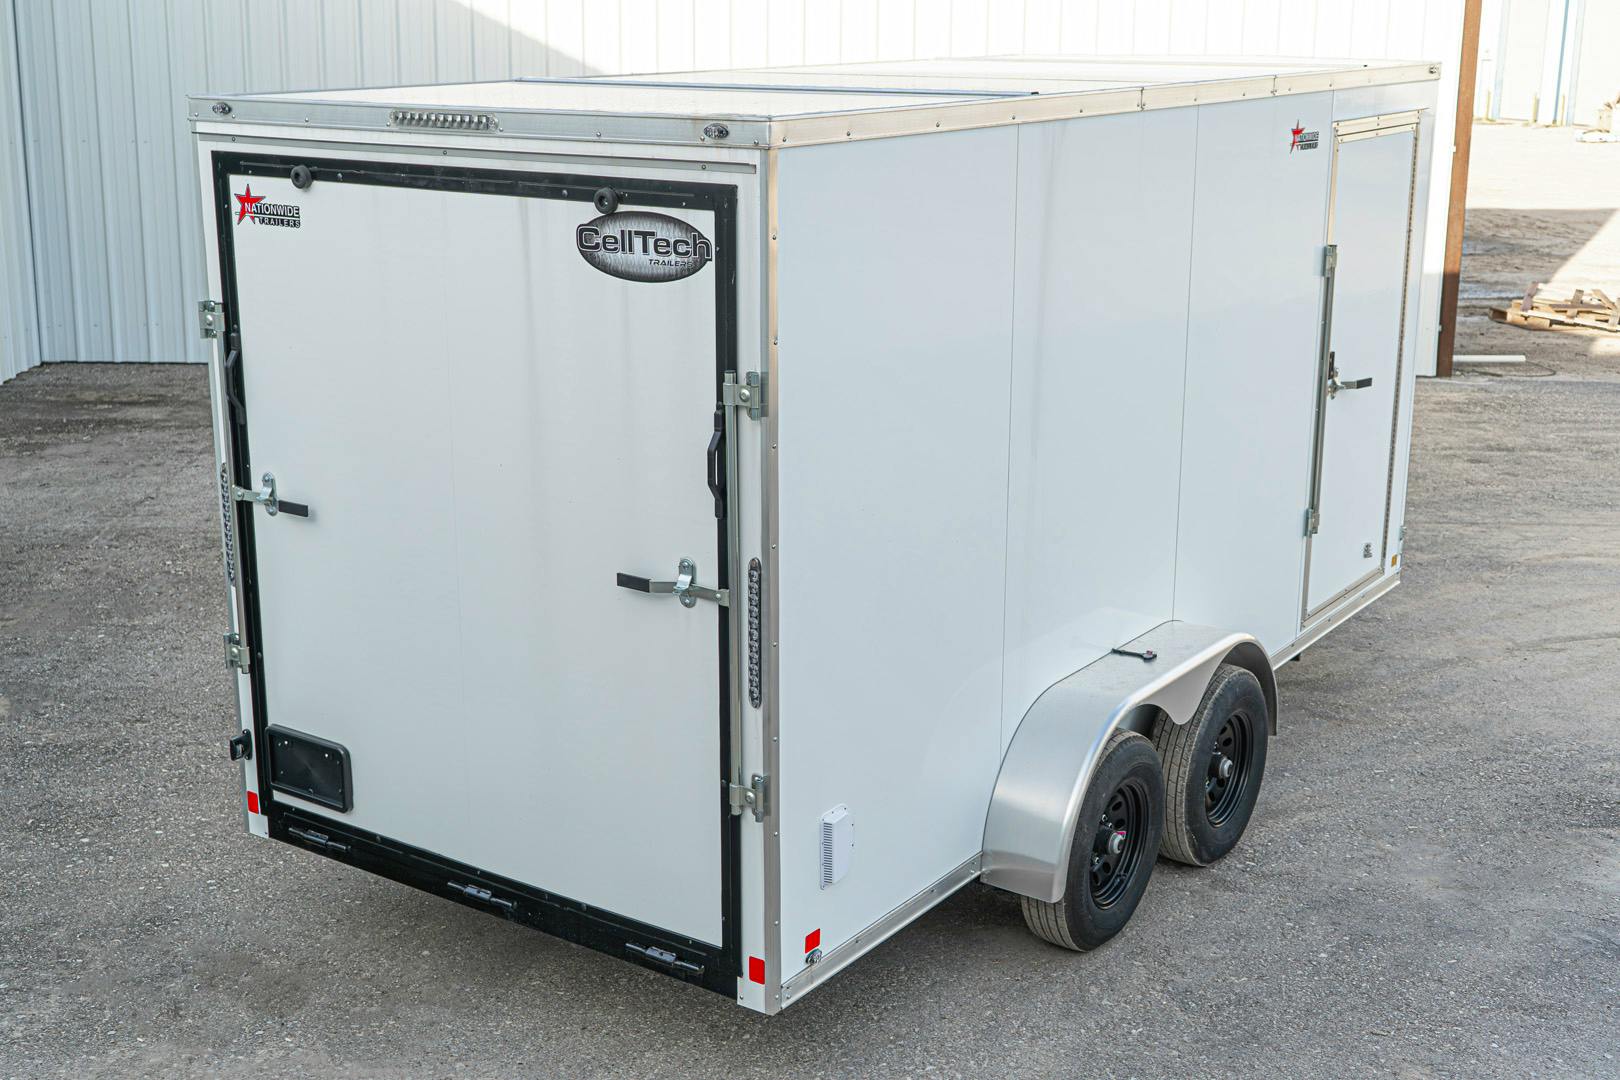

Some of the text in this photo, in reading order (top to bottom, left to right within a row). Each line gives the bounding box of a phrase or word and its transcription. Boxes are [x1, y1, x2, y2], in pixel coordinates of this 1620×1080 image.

[244, 202, 300, 217] NATIONWIDE
[259, 217, 301, 228] TRAILERS
[578, 225, 712, 260] CellTech
[648, 259, 693, 268] TRAILERS
